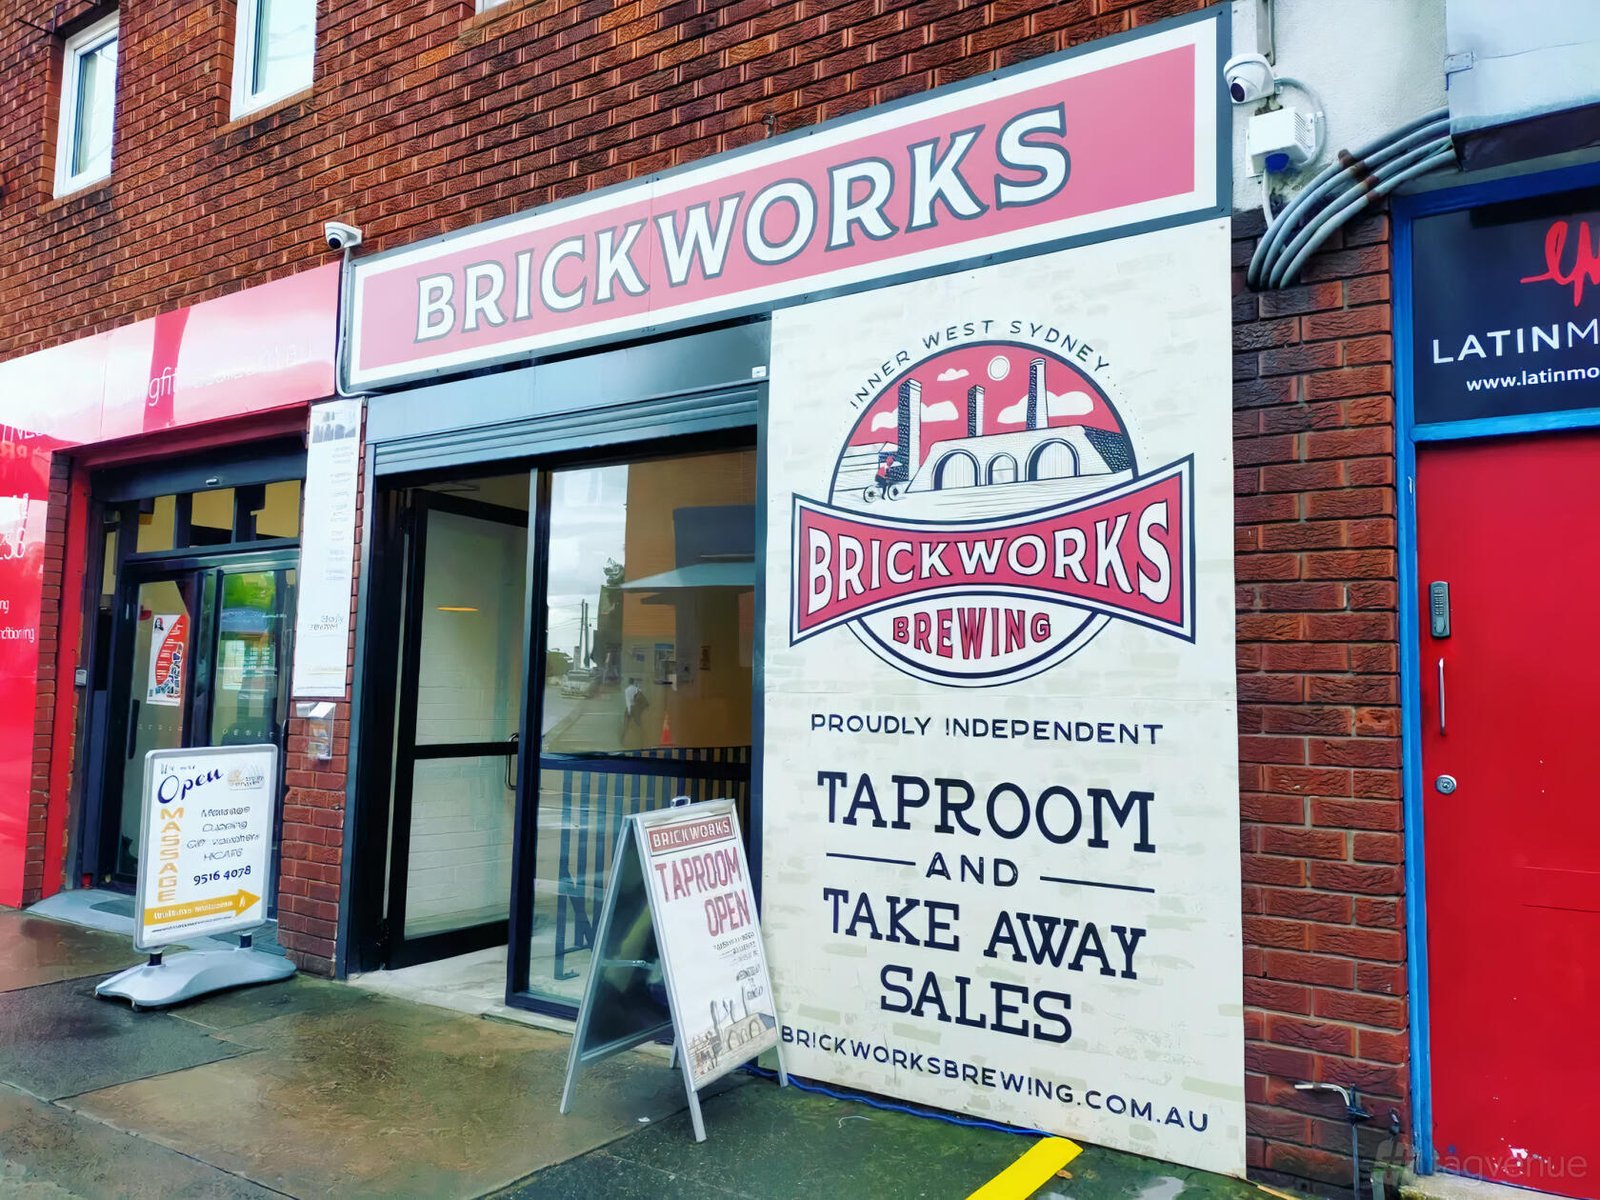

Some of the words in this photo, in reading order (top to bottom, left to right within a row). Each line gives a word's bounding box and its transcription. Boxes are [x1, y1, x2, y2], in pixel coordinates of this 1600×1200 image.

[413, 102, 1071, 344] BRICKWORKS
[849, 350, 912, 410] INNER
[922, 319, 995, 350] WEST
[1010, 319, 1111, 372] SYDNEY
[806, 498, 1172, 617] BRICKWORKS
[892, 606, 1052, 661] BREWING
[811, 713, 932, 736] PROUDLY
[945, 718, 1164, 745] INDEPENDENT
[157, 769, 224, 804] Open
[817, 770, 1157, 853] TAPROOM
[653, 821, 731, 848] BRICKWORKS
[193, 870, 221, 886] 9516
[223, 865, 252, 880] 4078
[655, 847, 741, 902] TAPROOM
[925, 851, 1019, 887] AND
[704, 890, 751, 937] OPEN
[823, 887, 960, 952] TAKE
[983, 910, 1147, 980] AWAY
[880, 964, 1072, 1044] SALES
[781, 1024, 1209, 1133] BRICKWORKSBREWING.COM.AU
